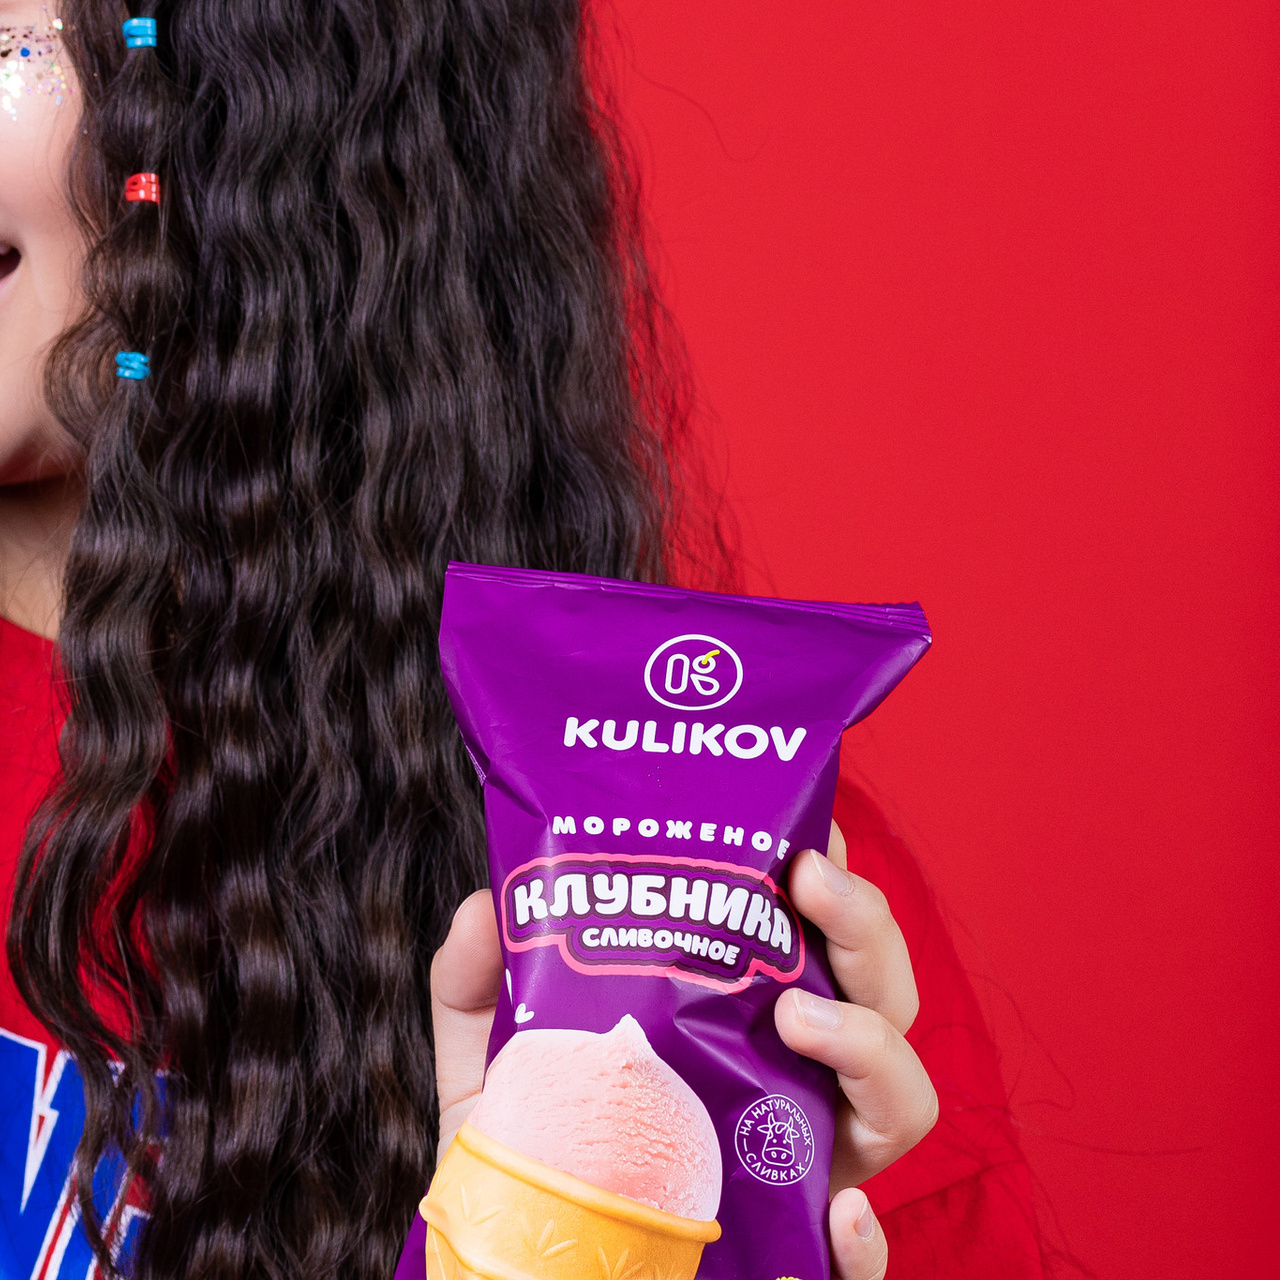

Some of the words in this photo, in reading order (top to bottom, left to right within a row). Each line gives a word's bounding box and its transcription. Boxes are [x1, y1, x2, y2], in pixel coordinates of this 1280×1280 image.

[563, 716, 807, 762] KULIKOV
[552, 815, 791, 860] МОРОЖЕНОЕ
[514, 873, 792, 955] КЛУБНИКА
[582, 927, 740, 966] СЛИВОЧНОЕ
[739, 1119, 755, 1136] НА
[751, 1098, 812, 1146] НАТУРАЛЬНЫХ
[745, 1152, 806, 1182] СЛИВКАХ
